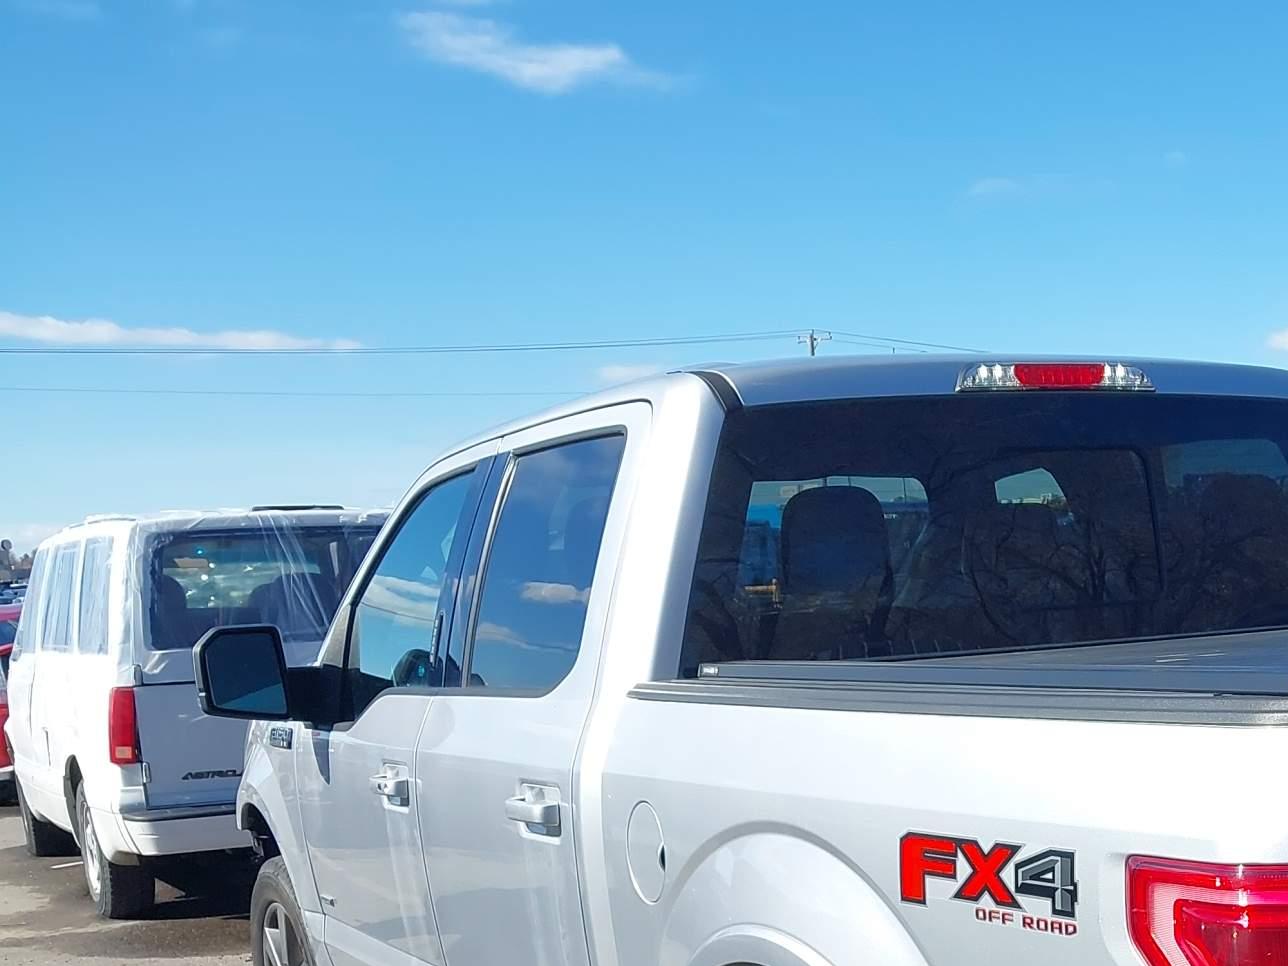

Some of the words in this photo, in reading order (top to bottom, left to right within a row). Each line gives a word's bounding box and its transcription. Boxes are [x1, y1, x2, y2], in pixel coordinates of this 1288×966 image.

[181, 769, 237, 780] ASTRO
[899, 831, 1080, 918] FX4
[975, 908, 1014, 926] OFF
[1022, 914, 1078, 937] ROAD
